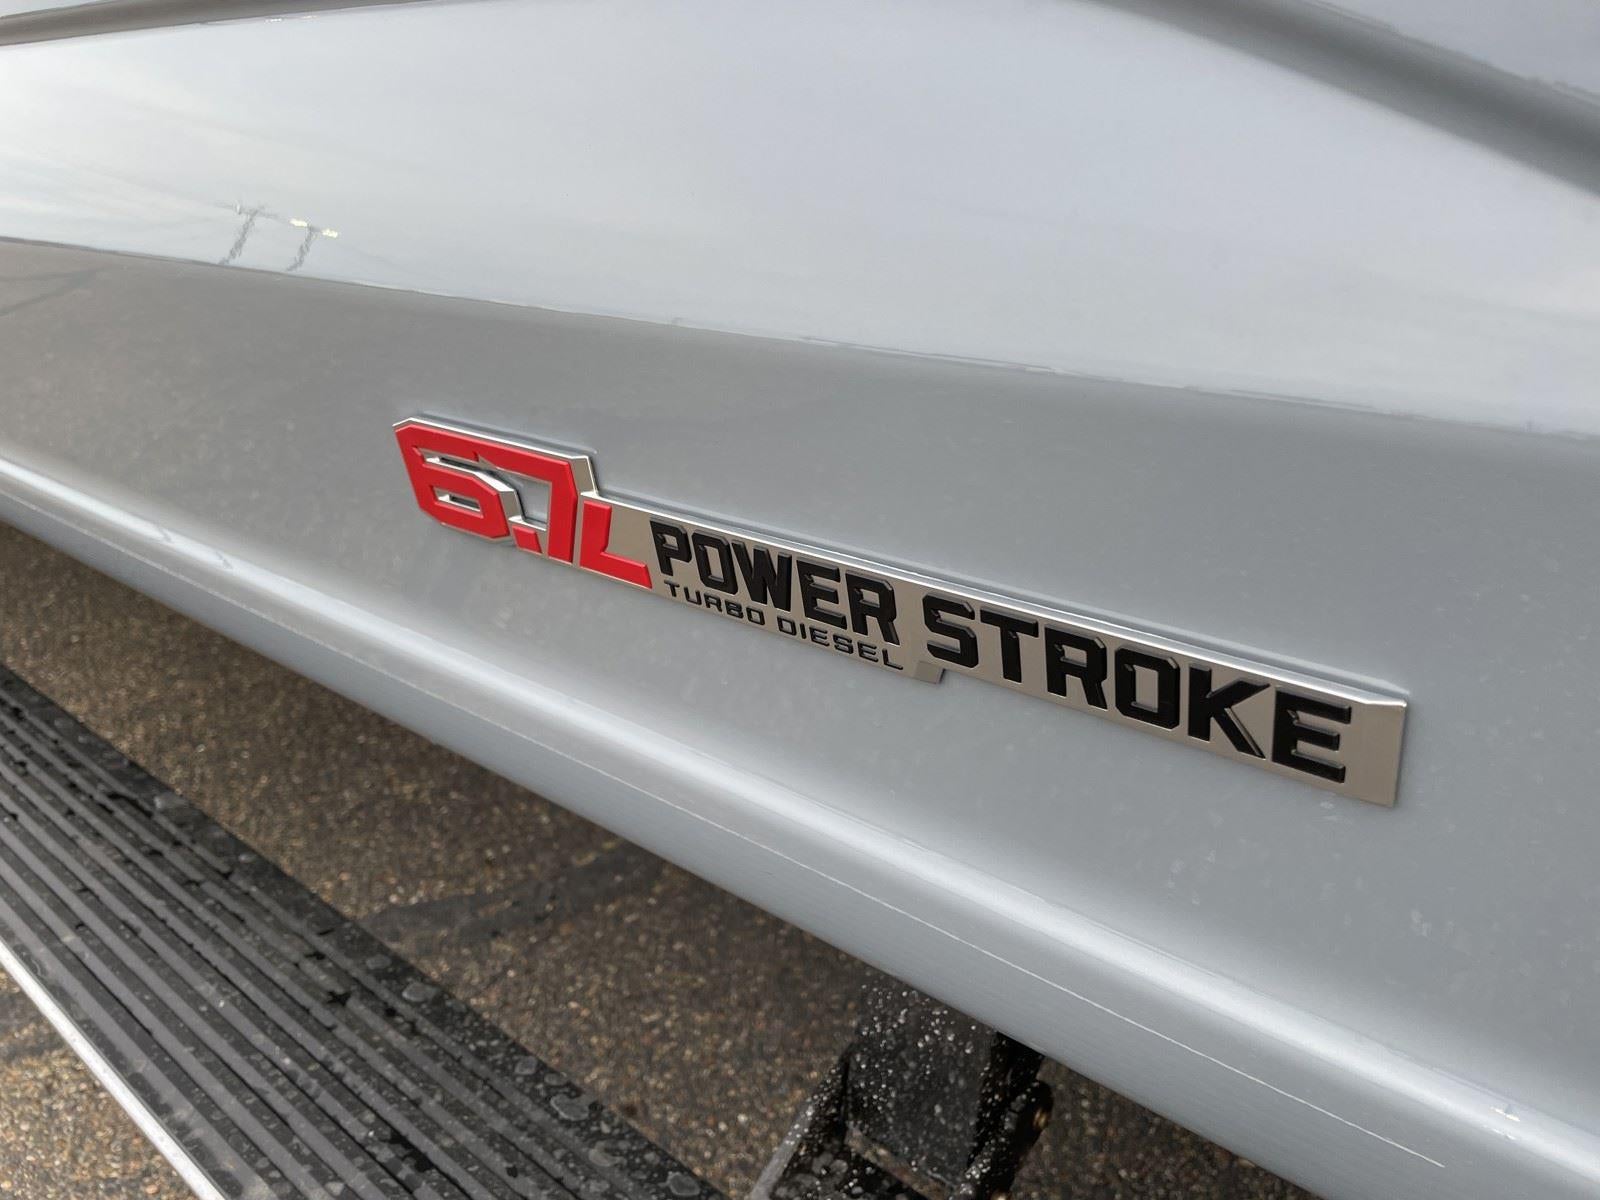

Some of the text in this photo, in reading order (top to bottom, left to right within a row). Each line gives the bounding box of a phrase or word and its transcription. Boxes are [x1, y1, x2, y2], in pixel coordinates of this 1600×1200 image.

[394, 422, 1352, 784] 6.7L POWER STROKE
[663, 579, 904, 671] TURBO DIESEL
